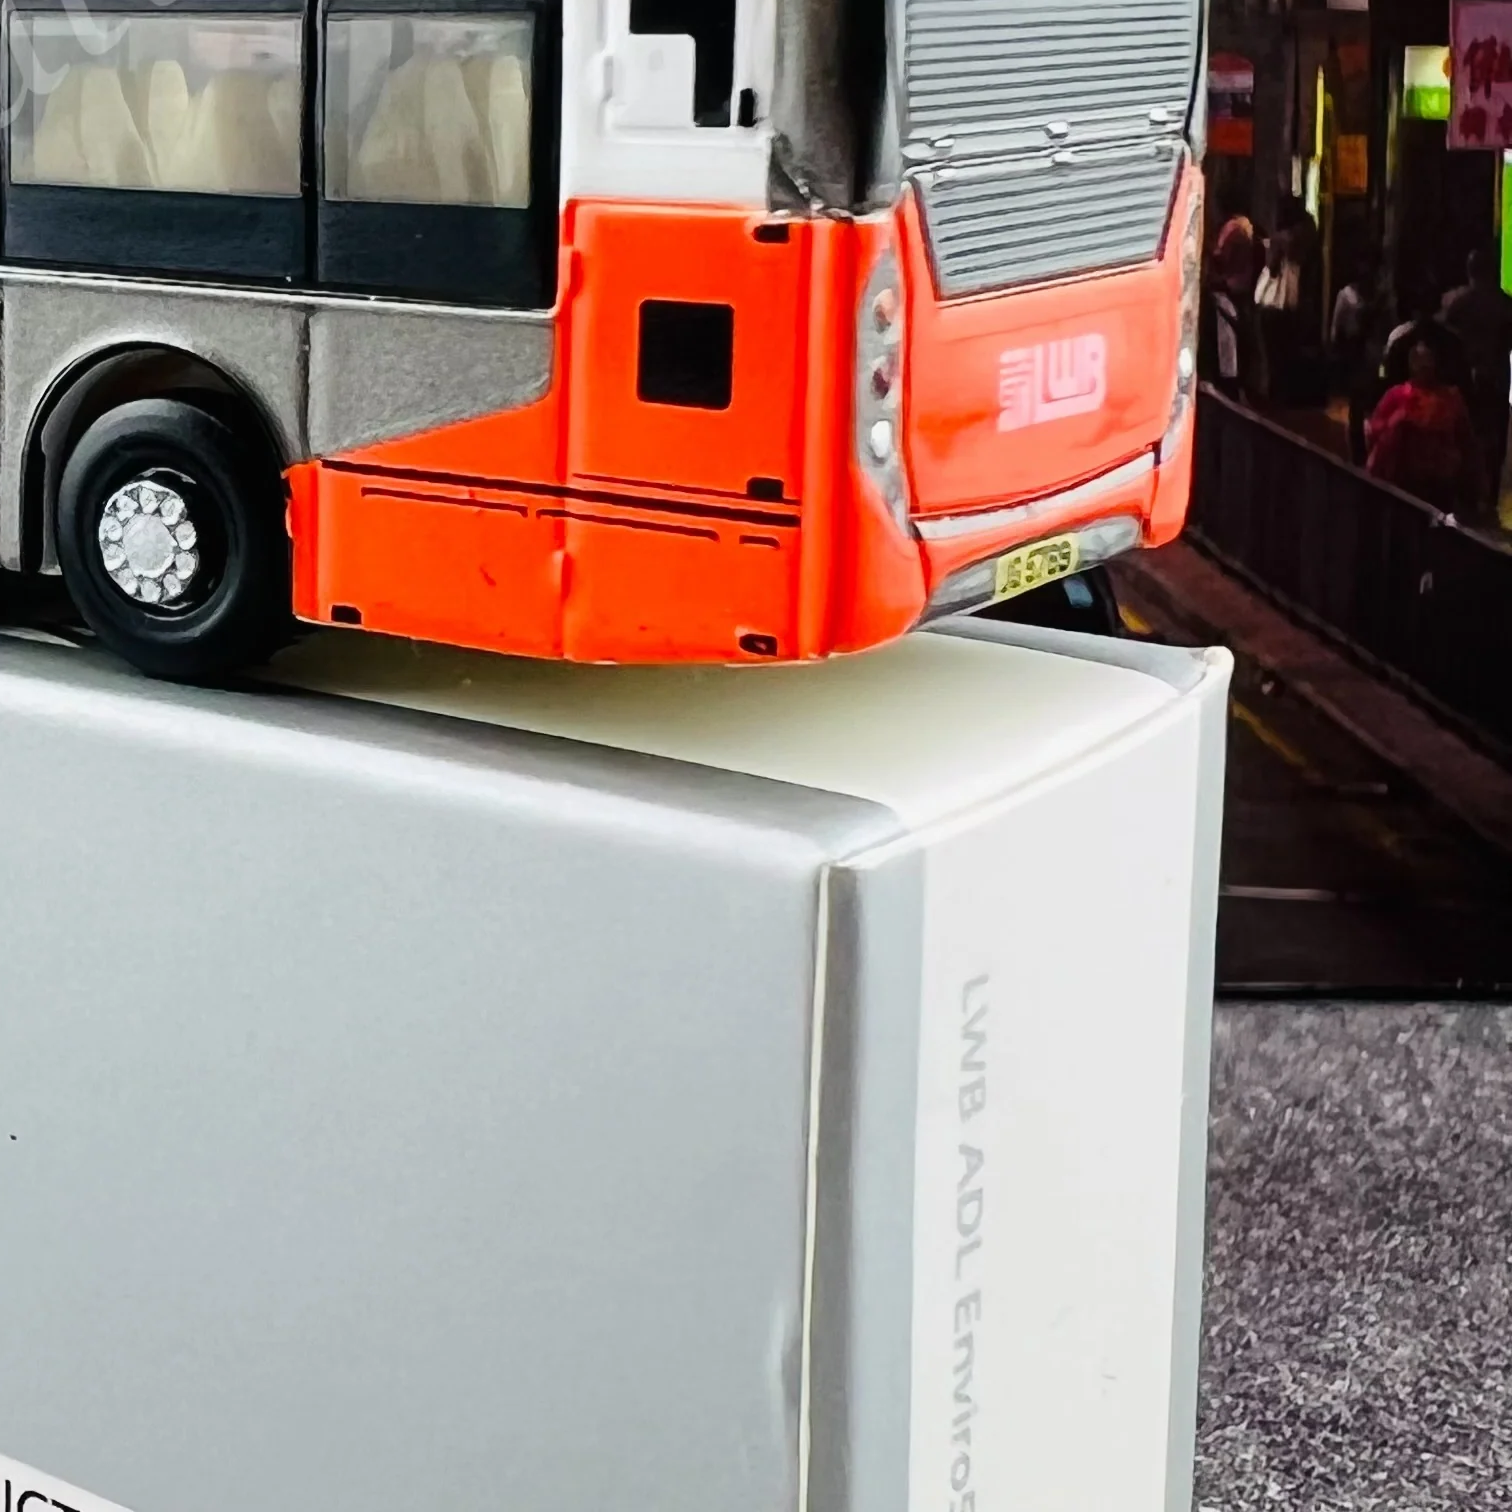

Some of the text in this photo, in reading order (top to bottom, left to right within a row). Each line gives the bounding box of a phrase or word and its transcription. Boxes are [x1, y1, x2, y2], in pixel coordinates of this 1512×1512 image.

[1034, 334, 1106, 424] LWB
[958, 974, 989, 1123] LWB
[955, 1143, 985, 1281] ADL
